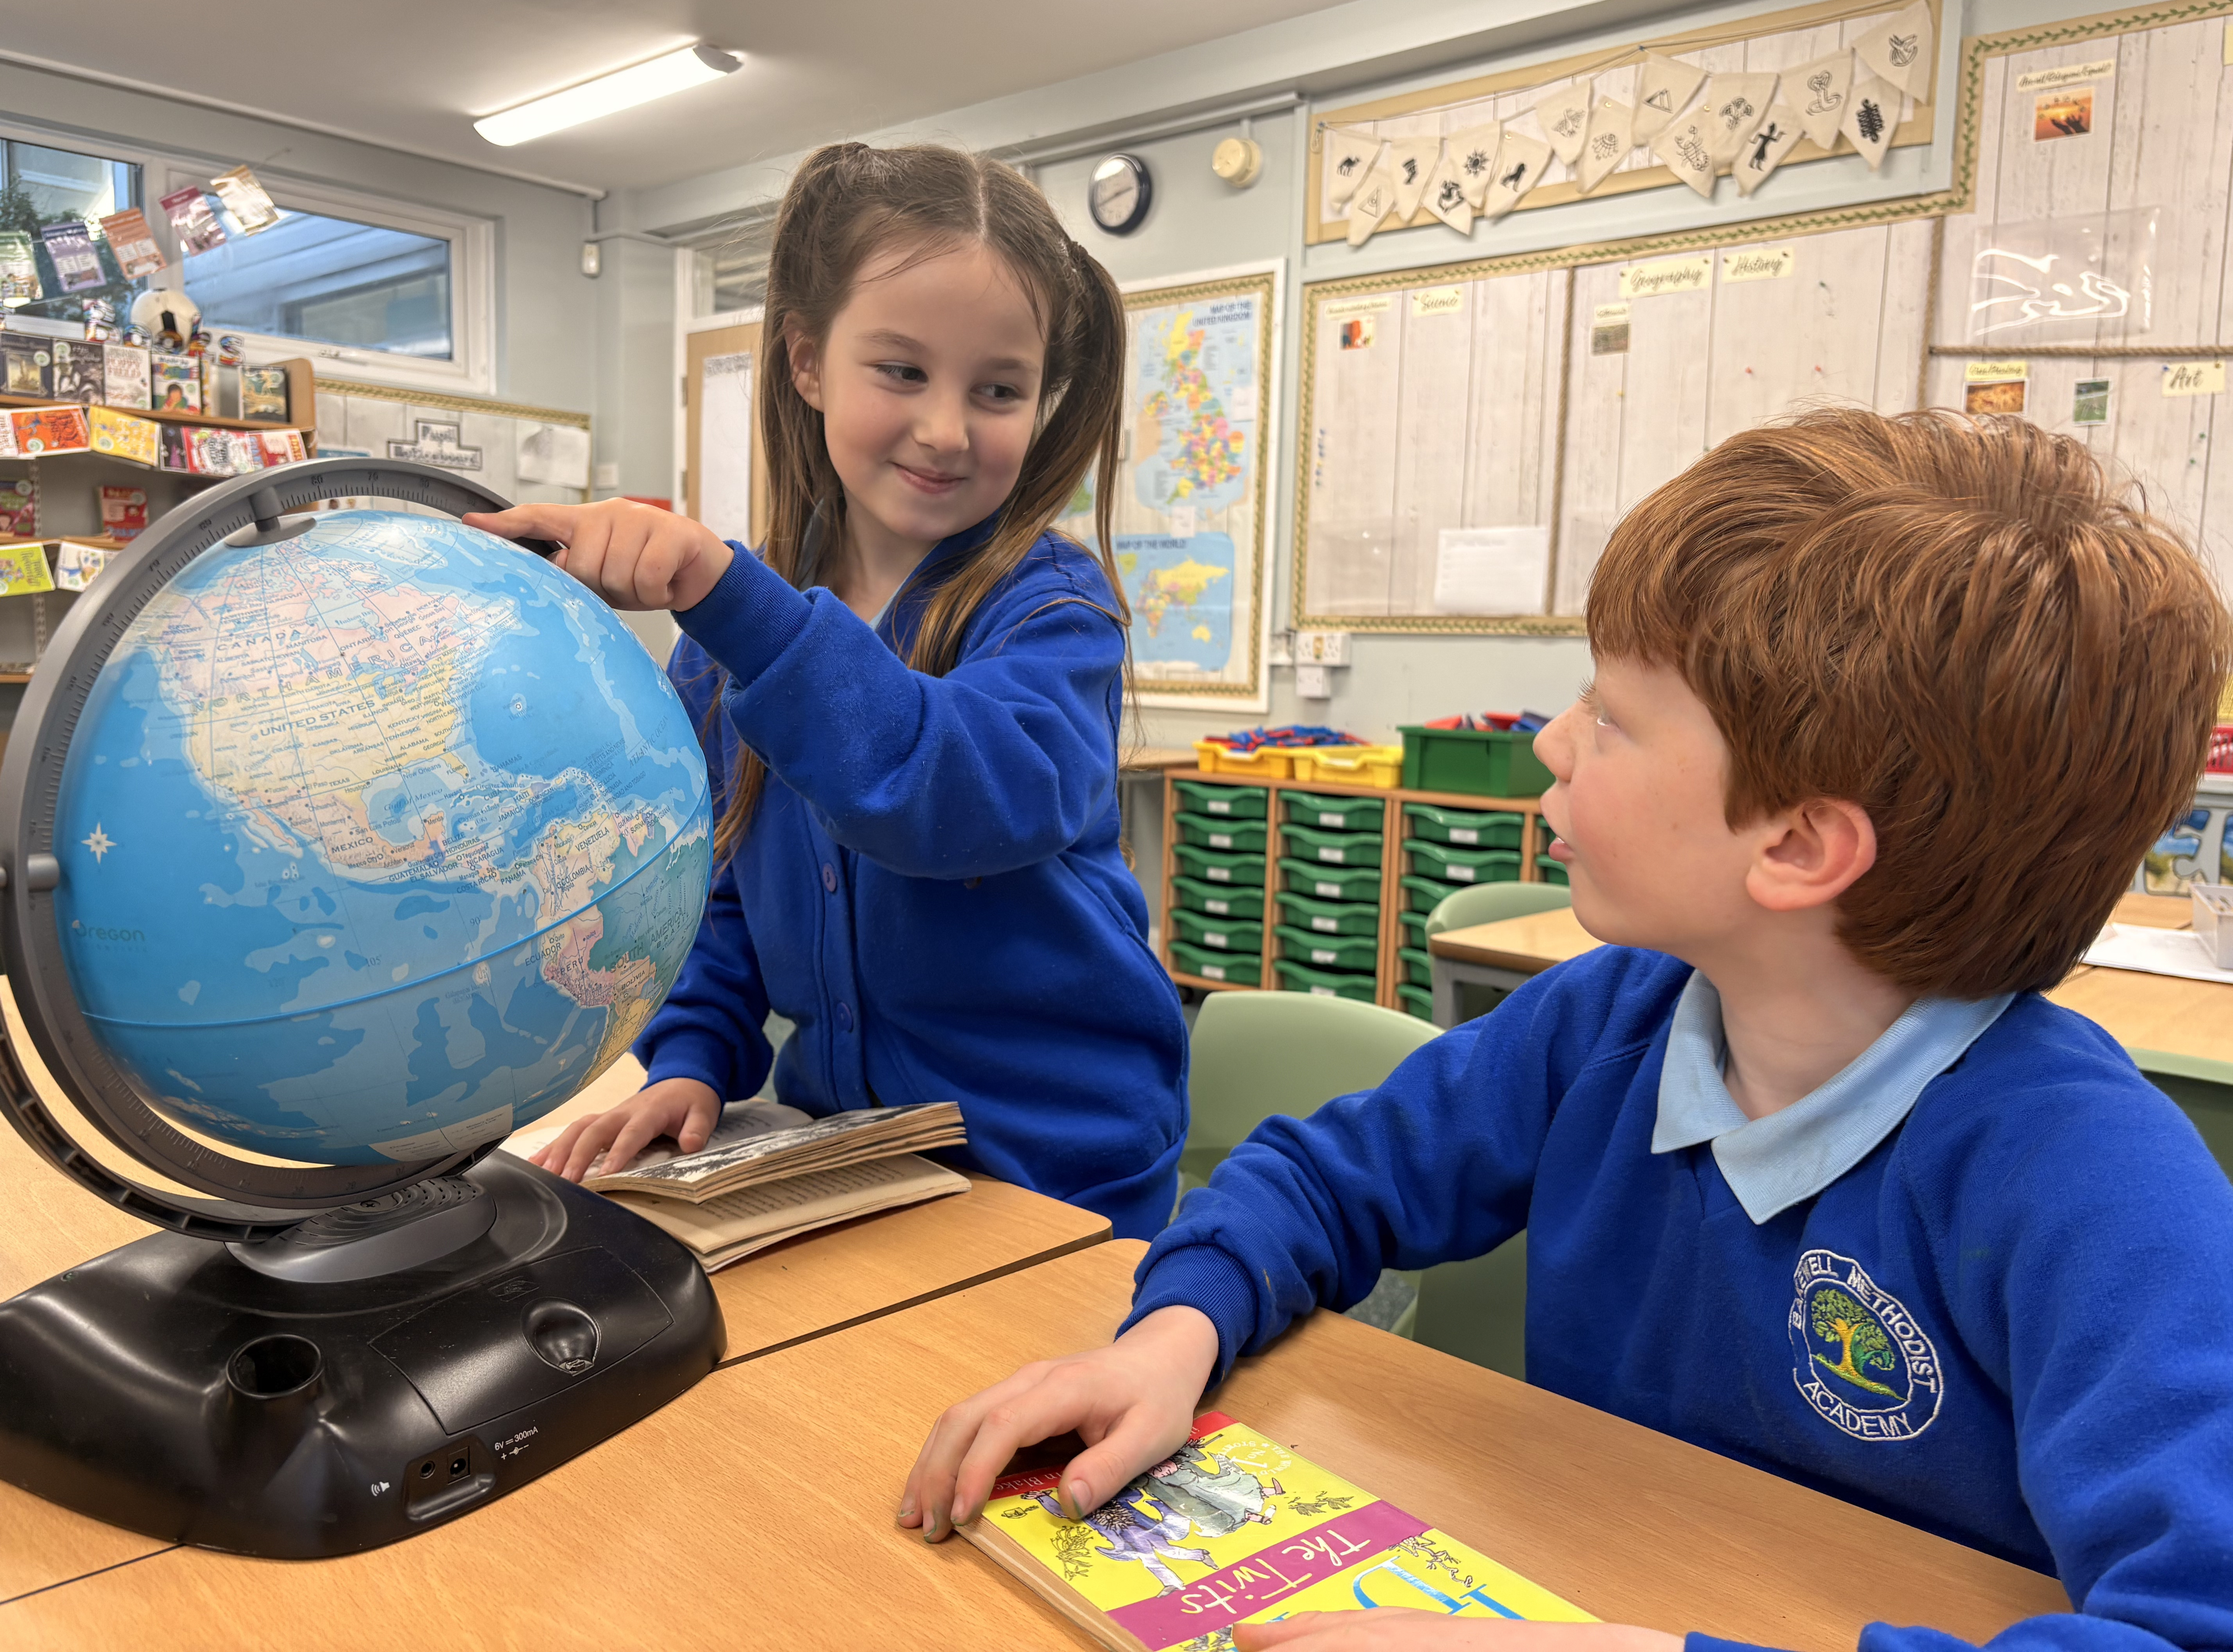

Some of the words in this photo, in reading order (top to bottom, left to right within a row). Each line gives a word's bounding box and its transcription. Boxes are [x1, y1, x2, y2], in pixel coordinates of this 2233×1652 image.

[1731, 255, 1784, 277] History
[1629, 267, 1704, 292] Geography
[2169, 364, 2204, 390] Art
[286, 634, 328, 650] MANITOBA
[339, 634, 376, 651] ONTARIO
[409, 702, 422, 711] WEST
[442, 690, 475, 707] Washington
[260, 717, 316, 736] UNITED
[319, 700, 375, 721] STATES
[363, 707, 389, 719] ILLINOIS
[387, 715, 420, 729] KENTUCKY
[421, 708, 443, 719] VIRGINIA
[426, 715, 444, 724] NORTH
[385, 726, 421, 741] TENNESSEE
[434, 728, 451, 737] SOUTH
[353, 741, 385, 755] ARKANSAS
[400, 738, 429, 751] ALABAMA
[423, 740, 446, 751] GEORGIA
[372, 762, 403, 776] LOUISIANA
[402, 772, 417, 781] New
[418, 763, 442, 775] Orleans
[446, 764, 467, 776] FLORIDA
[492, 754, 523, 773] BAHAMAS
[593, 761, 615, 779] DOMINICA
[330, 778, 350, 787] TEXAS
[602, 779, 623, 797] GRENADA
[484, 789, 502, 801] CUBA
[513, 790, 530, 803] HAITI
[498, 805, 525, 822] JAMAICA
[618, 813, 634, 829] GUYANA
[331, 836, 374, 855] MEXICO
[393, 842, 415, 854] Veracruz
[441, 831, 466, 847] BELIZE
[445, 837, 481, 855] HONDURAS
[575, 827, 610, 852] VENEZUELA
[466, 847, 505, 867] NICARAGUA
[389, 863, 434, 882] GUATEMALA
[420, 862, 459, 881] SALVADOR
[459, 870, 480, 882] Managua
[500, 870, 527, 885] PANAMA
[561, 864, 591, 886] COLOMBIA
[456, 880, 478, 894] COSTA
[477, 874, 494, 885] RICA
[75, 922, 145, 942] Oregon
[525, 942, 562, 966] ECUADOR
[560, 956, 583, 975] PERU
[621, 969, 645, 990] BOLIVIA
[1846, 1265, 1938, 1394] METHODIST
[1803, 1381, 1914, 1437] ACADEMY
[514, 1426, 539, 1443] 300mA
[1280, 1528, 1371, 1567] The
[1180, 1557, 1314, 1615] Twits
